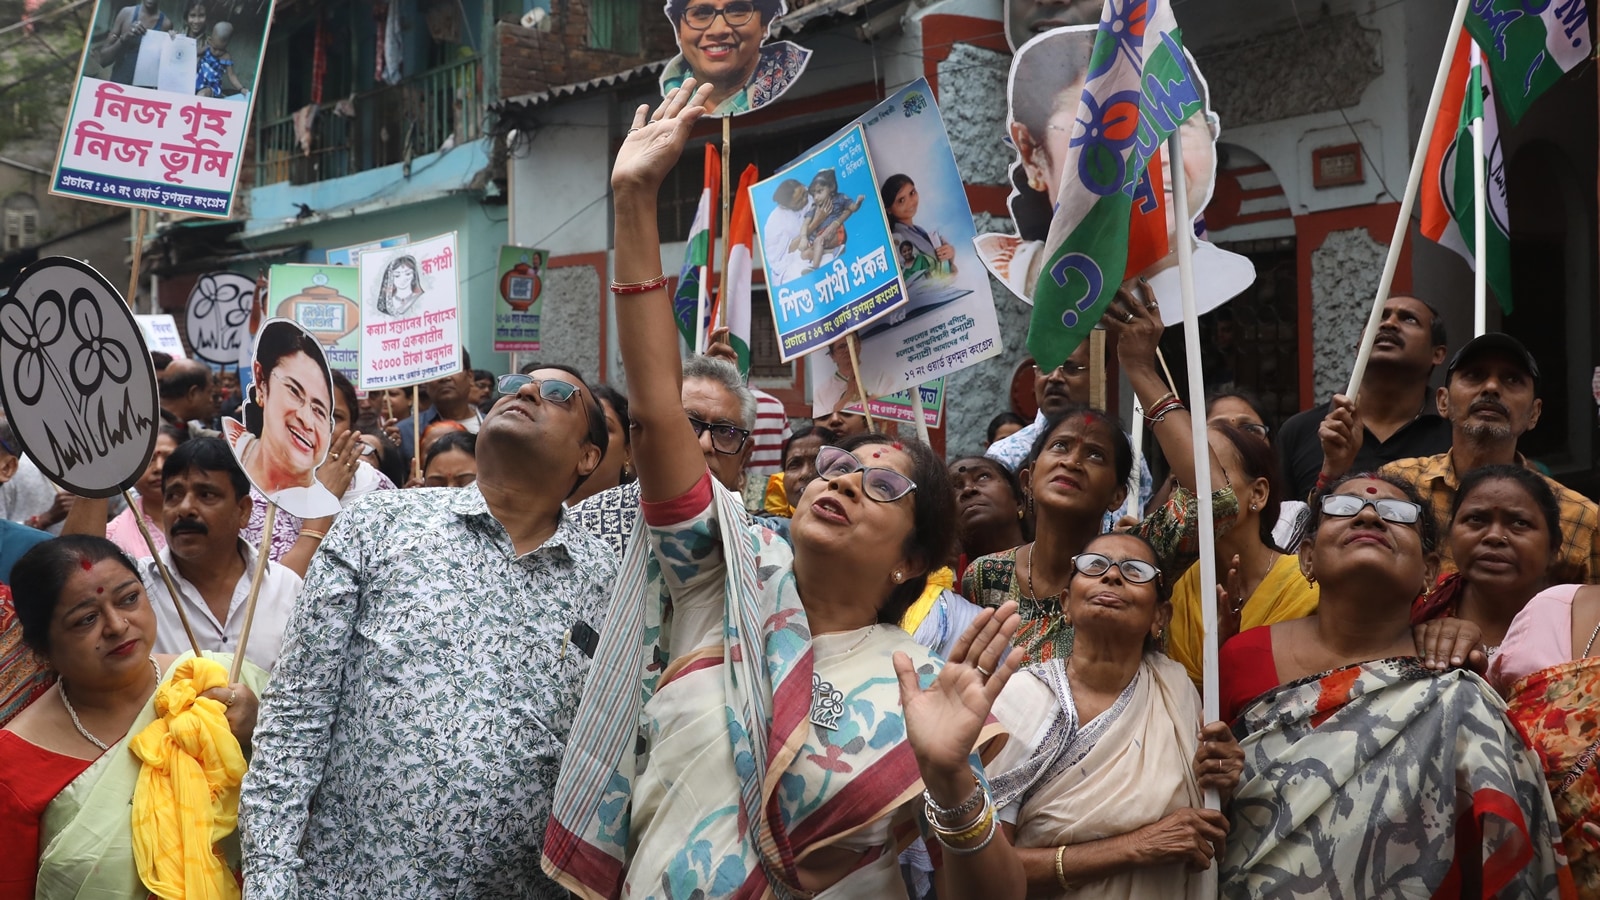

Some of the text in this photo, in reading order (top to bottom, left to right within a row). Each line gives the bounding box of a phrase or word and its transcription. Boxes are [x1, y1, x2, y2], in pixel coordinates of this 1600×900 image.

[94, 82, 232, 143] নিজ গৃহ
[74, 120, 233, 184] নিজ ভূমি
[61, 174, 94, 191] প্রচারে
[118, 186, 131, 197] নং
[133, 186, 160, 200] ওয়ার্ড
[162, 191, 191, 207] তৃণমূল
[193, 197, 228, 209] কংগ্রেস
[421, 247, 453, 275] রূপশ্রী
[778, 245, 889, 322] শিশু সাথী প্রকল্প
[367, 307, 456, 336] কন্যা সন্তানের বিবাহের
[784, 333, 807, 349] প্রচারে
[824, 321, 834, 332] নং
[834, 305, 852, 328] ওয়ার্ড
[853, 297, 875, 320] তৃণমূল
[875, 283, 899, 304] কংগ্রেস
[950, 318, 975, 334] কন্যাশ্রী
[382, 326, 443, 351] জন্য এককালীন
[907, 347, 932, 362] কন্যাশ্রী
[372, 344, 453, 371] ২৫০০০ টাকা অনুদান
[904, 338, 994, 381] ১৭ নং ওয়ার্ড তৃণমূল কংগ্রেস
